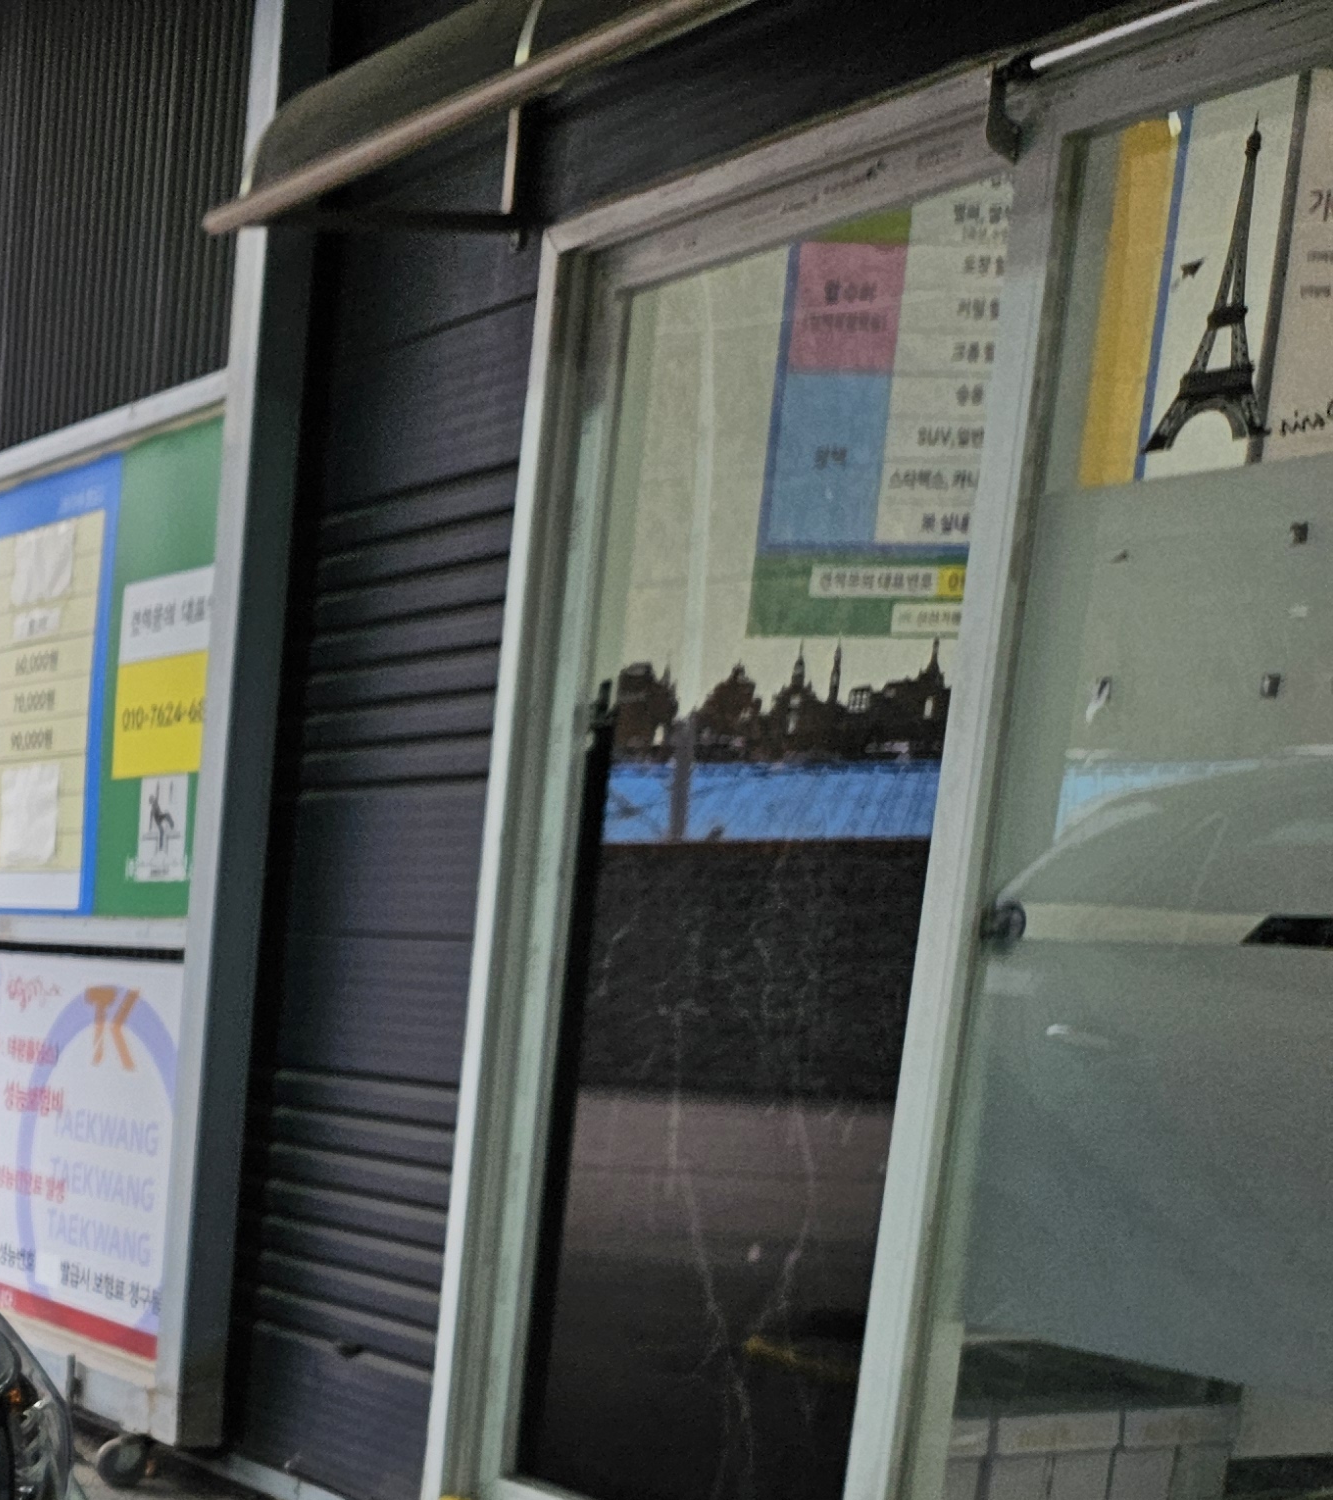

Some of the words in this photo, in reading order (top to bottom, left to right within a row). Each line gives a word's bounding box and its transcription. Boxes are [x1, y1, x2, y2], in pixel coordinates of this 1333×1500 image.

[917, 426, 984, 449] SUV,일반
[53, 1108, 159, 1158] TAEKWANG
[48, 1156, 155, 1213] TAEKWANG
[46, 1206, 151, 1266] TAEKWANG
